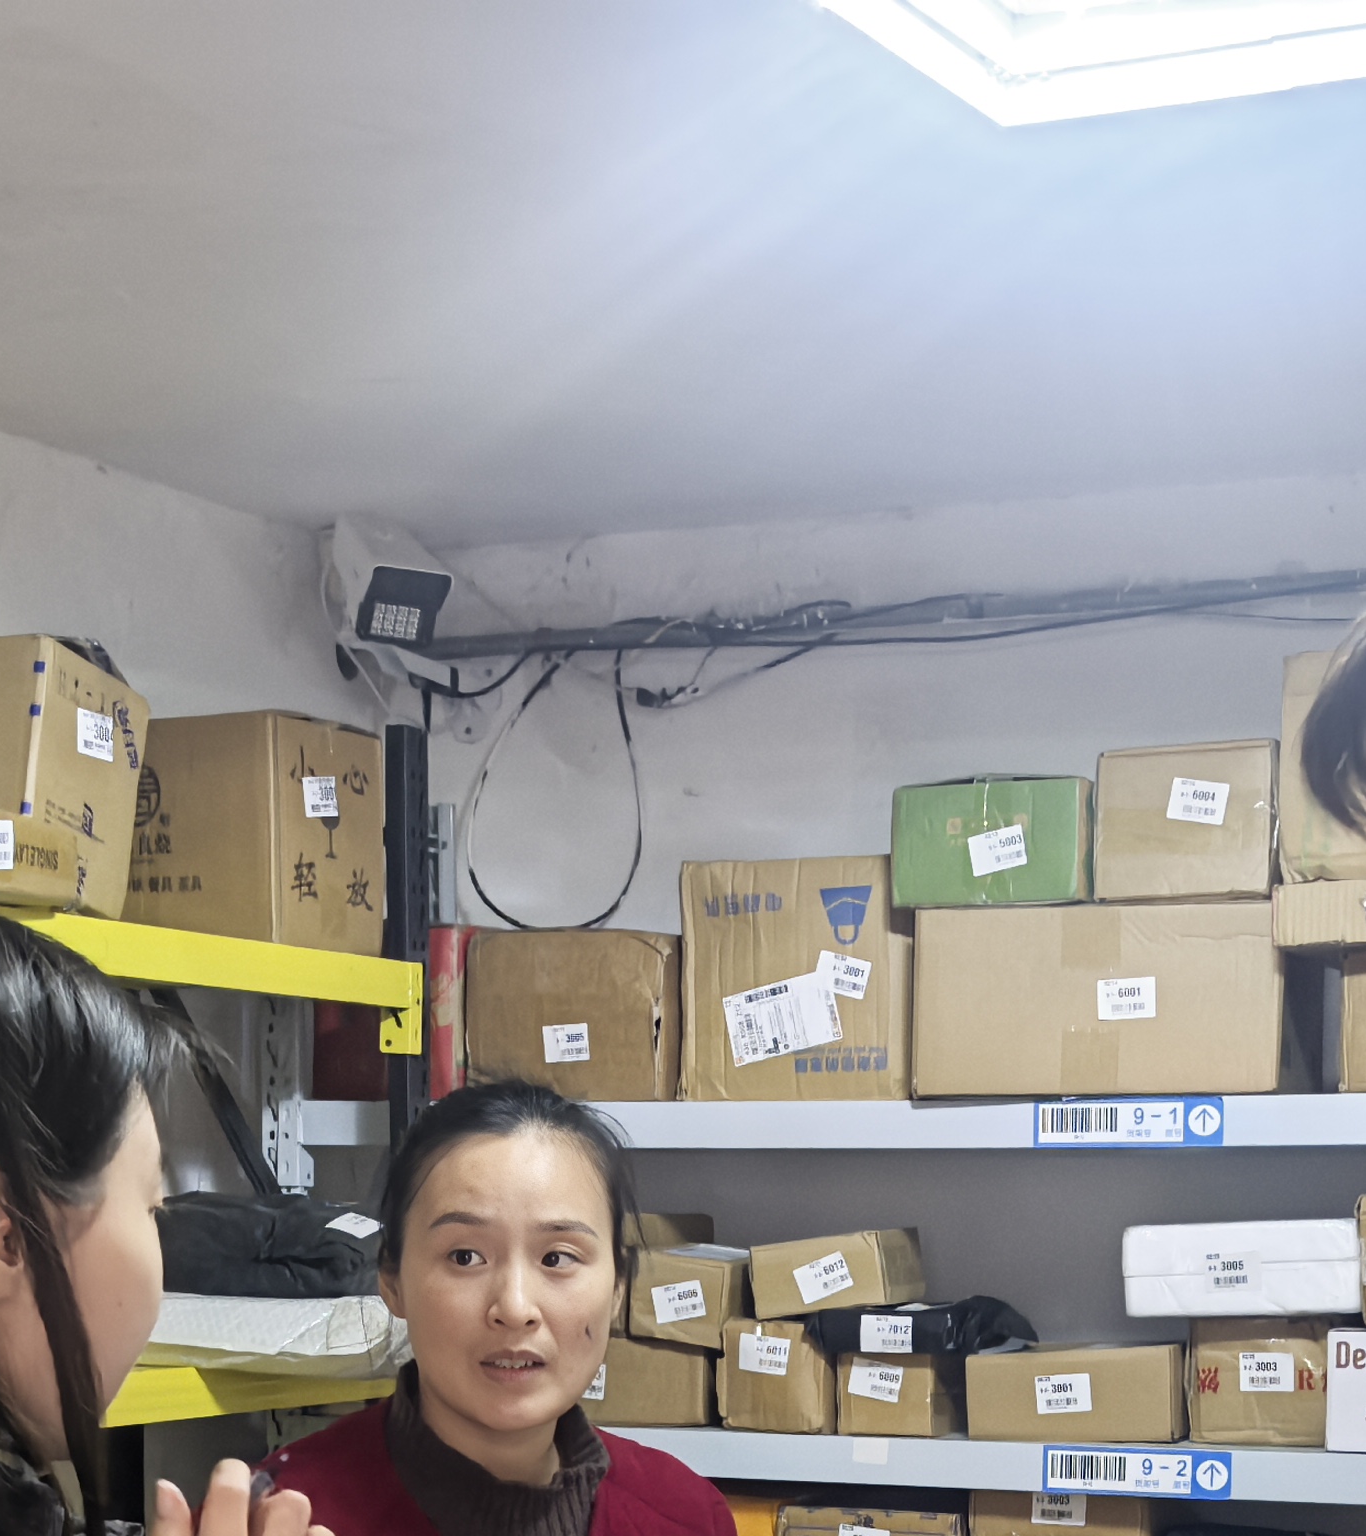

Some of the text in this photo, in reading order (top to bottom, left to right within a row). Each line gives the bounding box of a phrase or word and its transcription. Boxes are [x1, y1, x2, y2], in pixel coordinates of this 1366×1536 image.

[290, 745, 369, 796] 小心
[1192, 789, 1216, 802] 6004
[291, 852, 374, 912] 轻放
[842, 964, 865, 979] 3001
[1117, 987, 1141, 998] 6001
[822, 1259, 845, 1276] 6012
[1220, 1260, 1244, 1272] 3005
[1254, 1361, 1278, 1372] 3003
[1051, 1382, 1073, 1393] 3001
